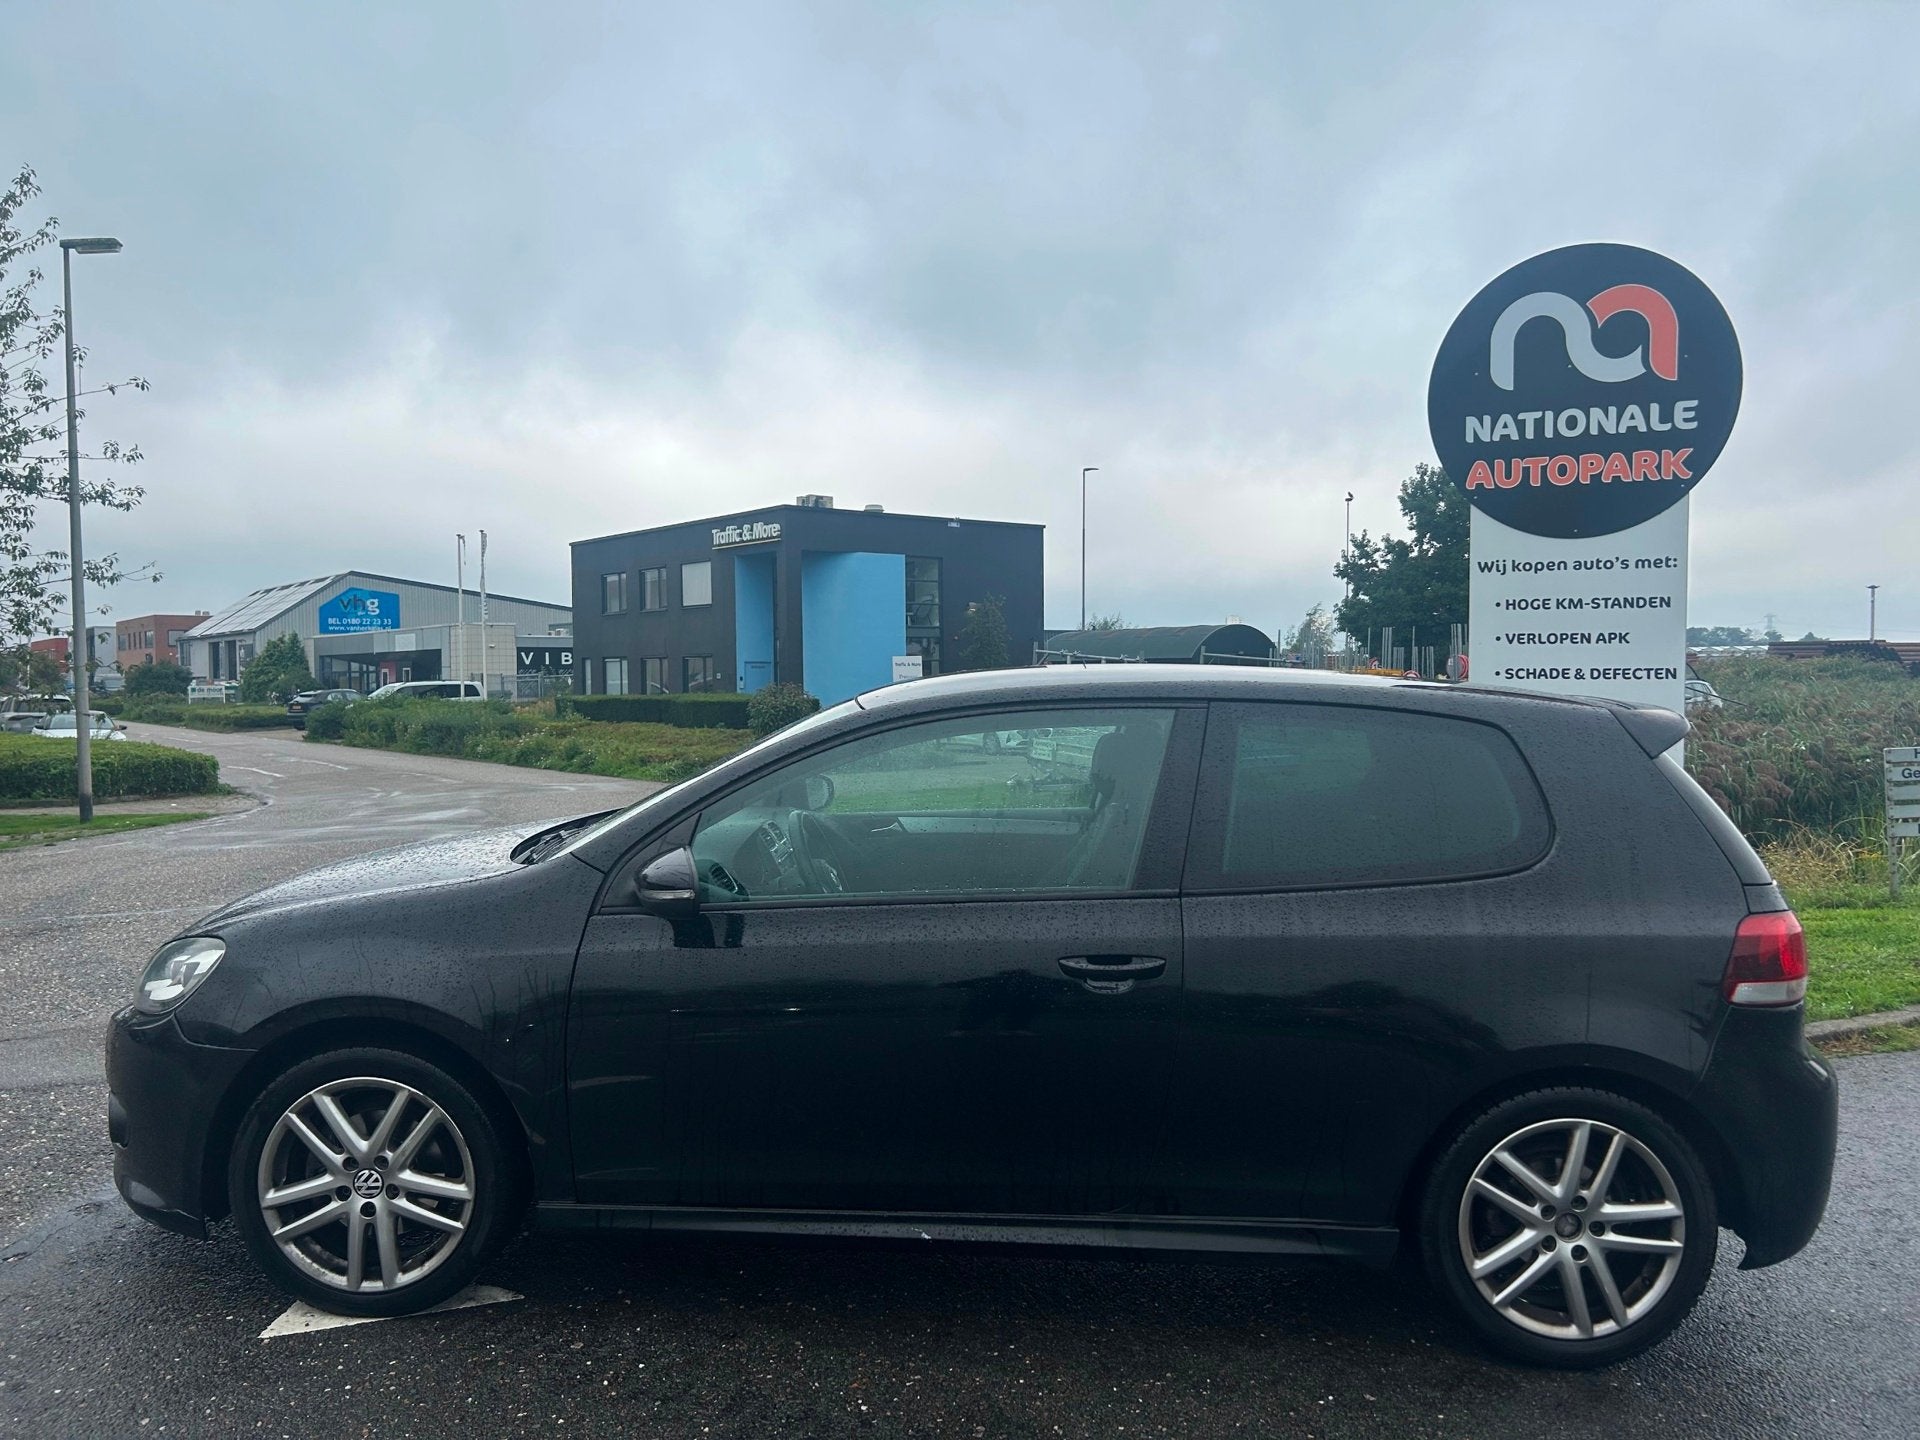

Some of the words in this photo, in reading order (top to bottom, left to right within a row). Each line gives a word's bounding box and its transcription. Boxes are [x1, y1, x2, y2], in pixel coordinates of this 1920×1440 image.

[1465, 399, 1699, 443] NATIONALE
[1465, 447, 1694, 490] AUTOPARK
[711, 528, 742, 545] Traffic
[742, 524, 752, 541] &
[752, 521, 780, 539] More
[1477, 559, 1507, 576] Wij
[1511, 558, 1568, 574] kopen
[1634, 556, 1678, 569] met:
[339, 594, 380, 616] vhg
[1505, 598, 1551, 611] HOGE
[1555, 596, 1672, 610] KM-STANDEN
[327, 617, 341, 625] BEL
[342, 617, 361, 625] 0180
[1505, 633, 1591, 645] VERLOPEN
[1595, 632, 1631, 644] APK
[1505, 668, 1571, 680] SCHADE
[1574, 668, 1586, 680] &
[1589, 667, 1677, 680] DEFECTEN
